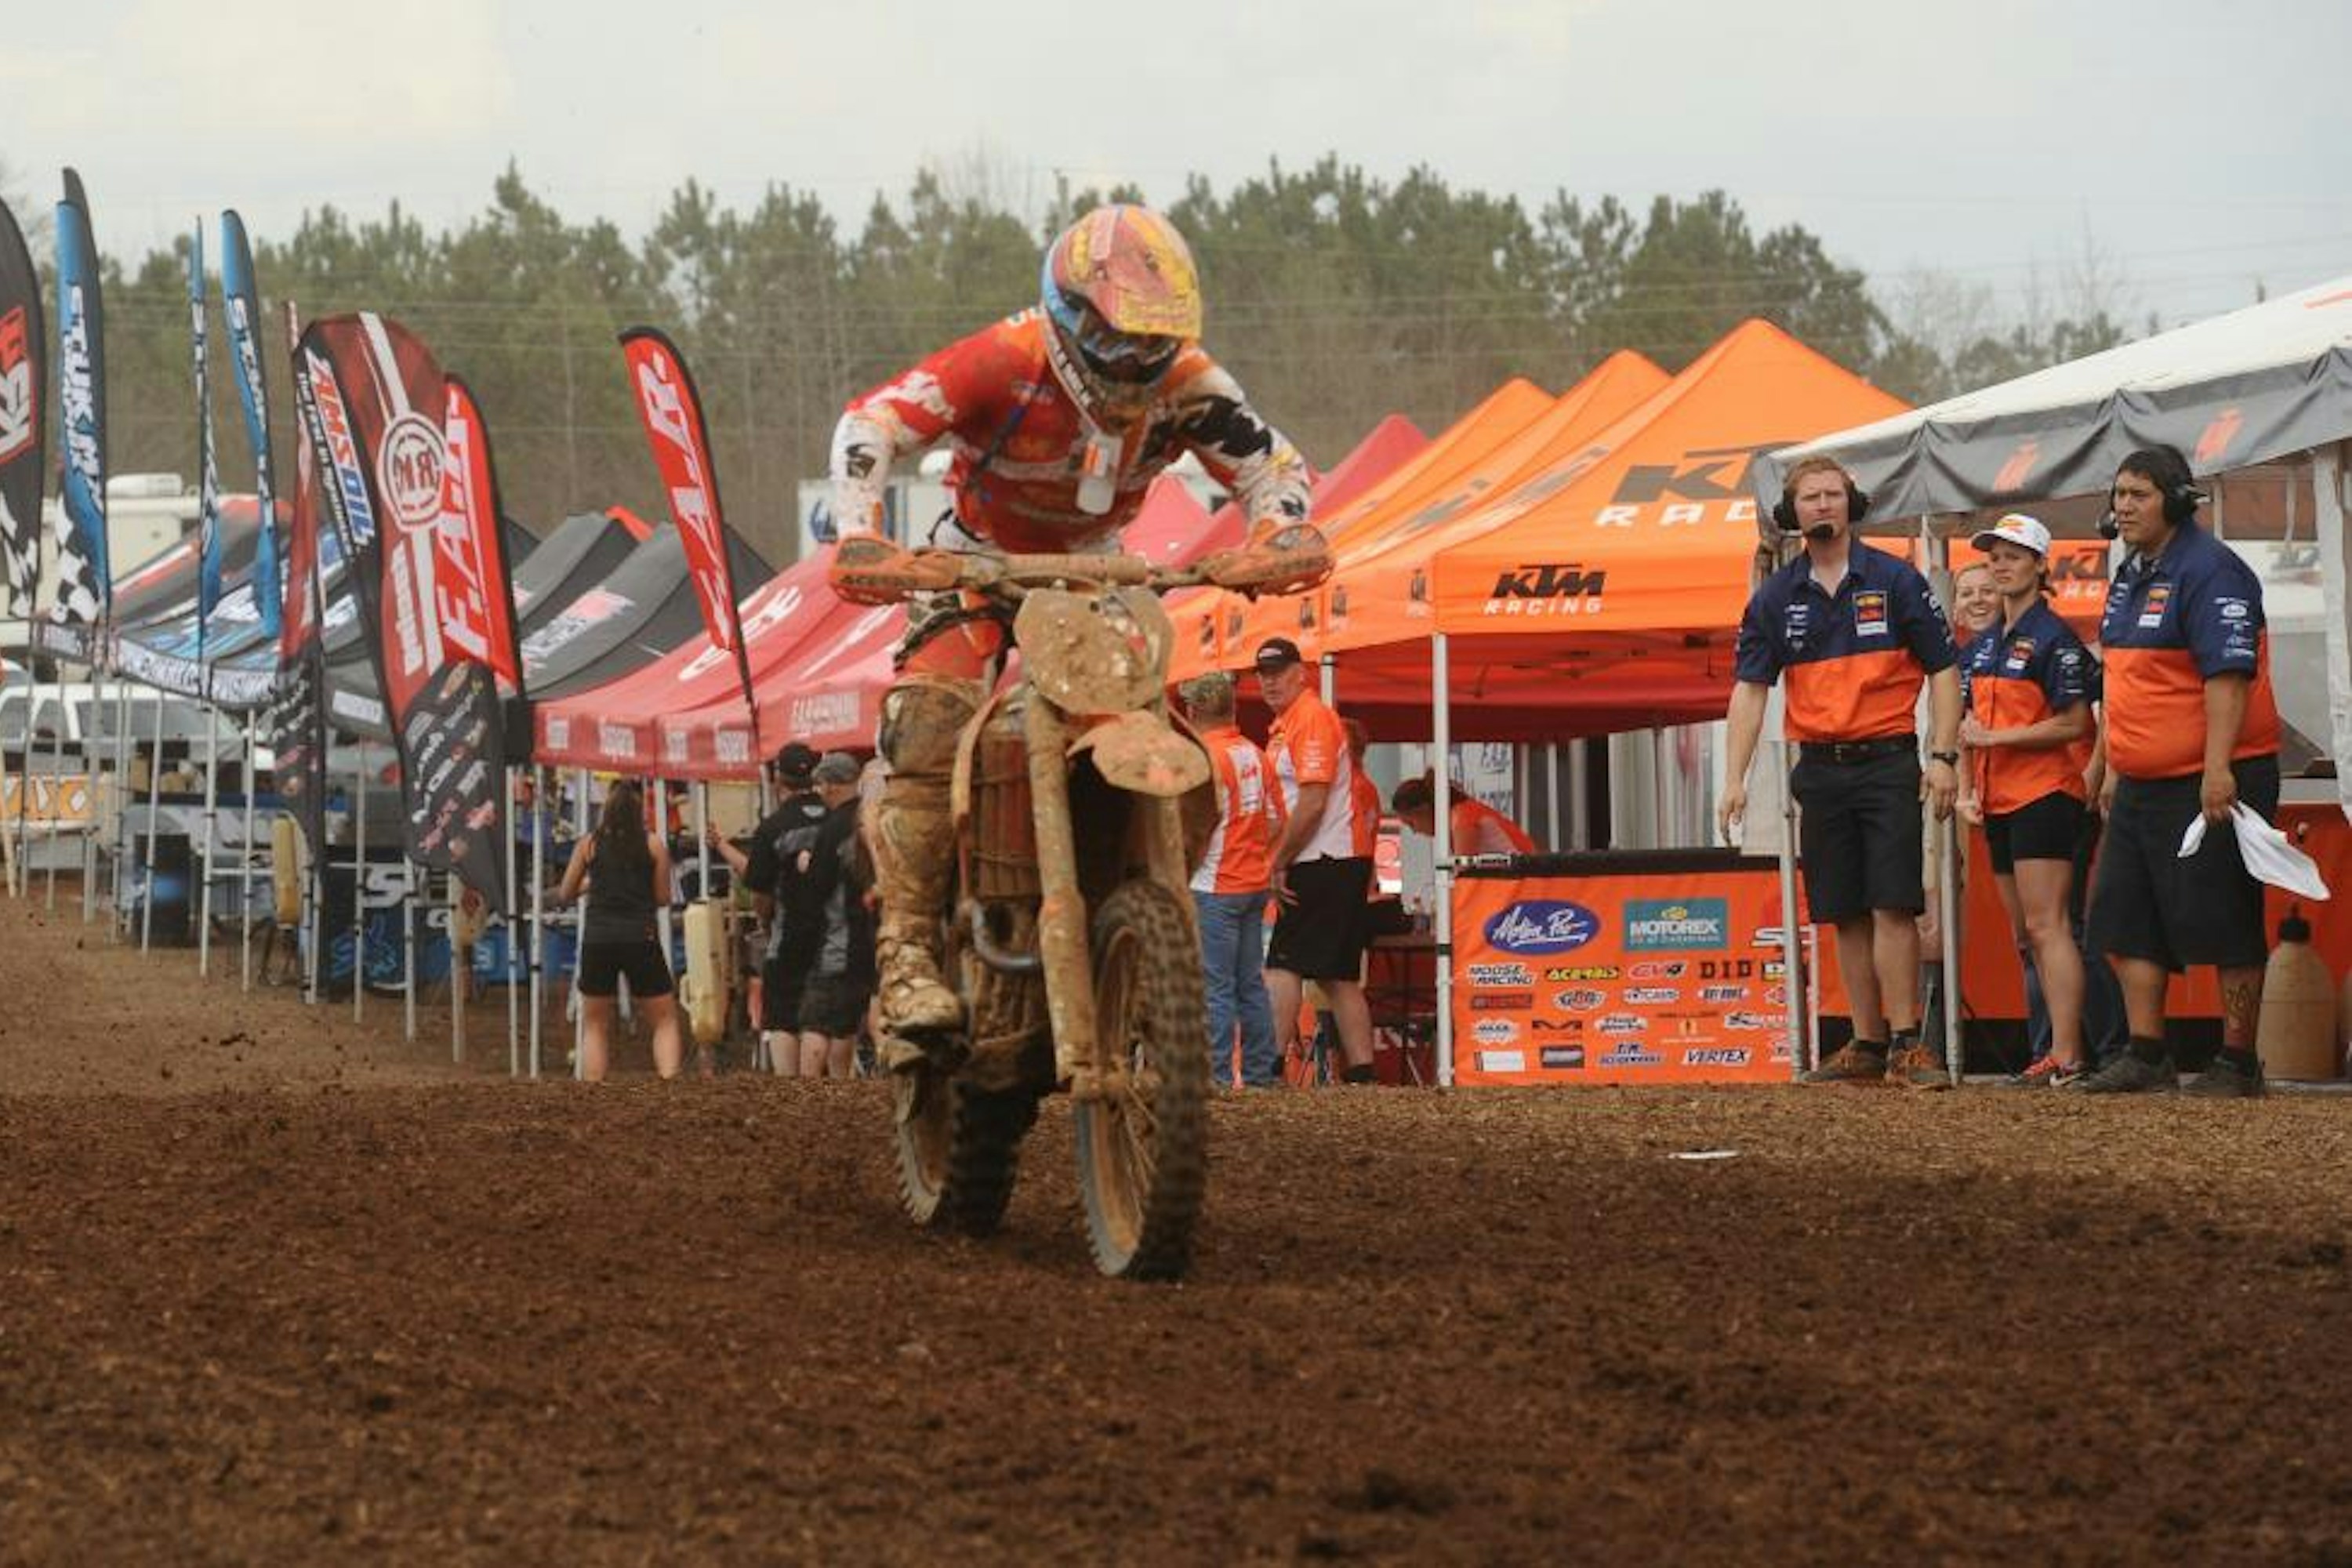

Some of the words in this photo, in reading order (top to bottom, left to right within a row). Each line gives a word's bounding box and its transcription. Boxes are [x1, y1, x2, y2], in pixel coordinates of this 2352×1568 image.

[304, 347, 376, 546] AMSOIL
[1610, 441, 1788, 503] KT
[1595, 501, 1758, 528] RAC
[1491, 564, 1607, 598] KTM
[1483, 598, 1604, 615] RACING
[1630, 918, 1719, 937] MOTOREX
[1687, 1049, 1747, 1063] VERTEX
